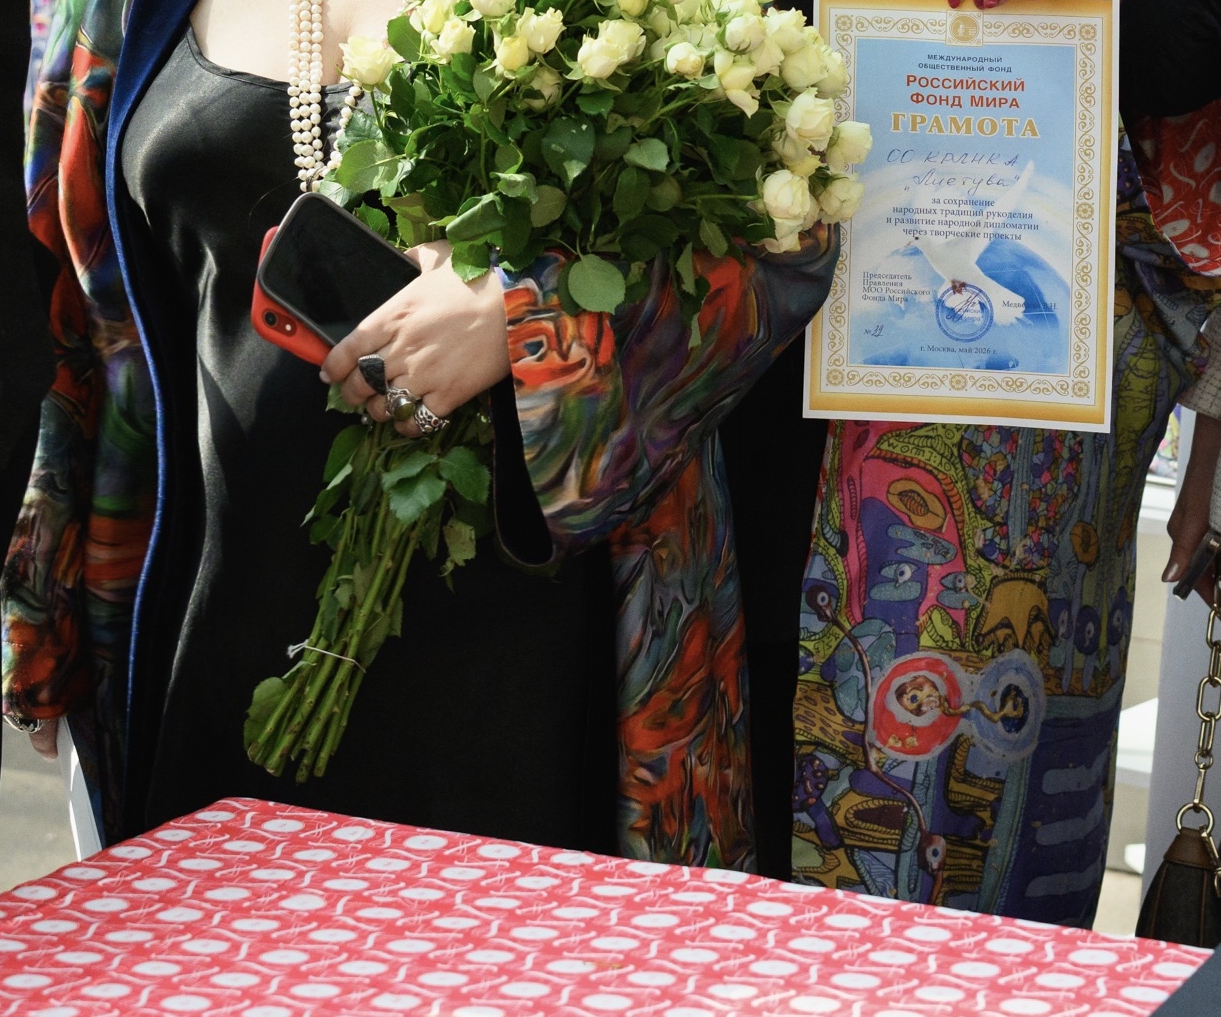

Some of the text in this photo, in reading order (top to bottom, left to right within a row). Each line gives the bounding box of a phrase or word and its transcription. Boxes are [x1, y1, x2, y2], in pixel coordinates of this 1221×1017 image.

[927, 54, 1003, 63] МЕЖДУНАРОДНЫЙ
[918, 62, 985, 72] ОБЩЕСТВЕННЫЙ
[906, 74, 1025, 92] РОССИЙСКИЙ
[910, 92, 1020, 109] ФОНД МИРА
[890, 111, 1041, 138] ГРАМОТА
[943, 198, 995, 208] сохранение
[892, 206, 1033, 220] народных традиций рукоделия
[894, 217, 936, 226] развитие
[938, 219, 981, 228] народной
[983, 222, 1039, 231] дипломатии
[902, 229, 1022, 241] через творческие проекты
[862, 271, 912, 280] Председатель
[862, 279, 903, 288] Правления
[862, 286, 930, 295] МОО Российского
[862, 294, 908, 304] Фонда Мира
[927, 344, 957, 353] Москва,
